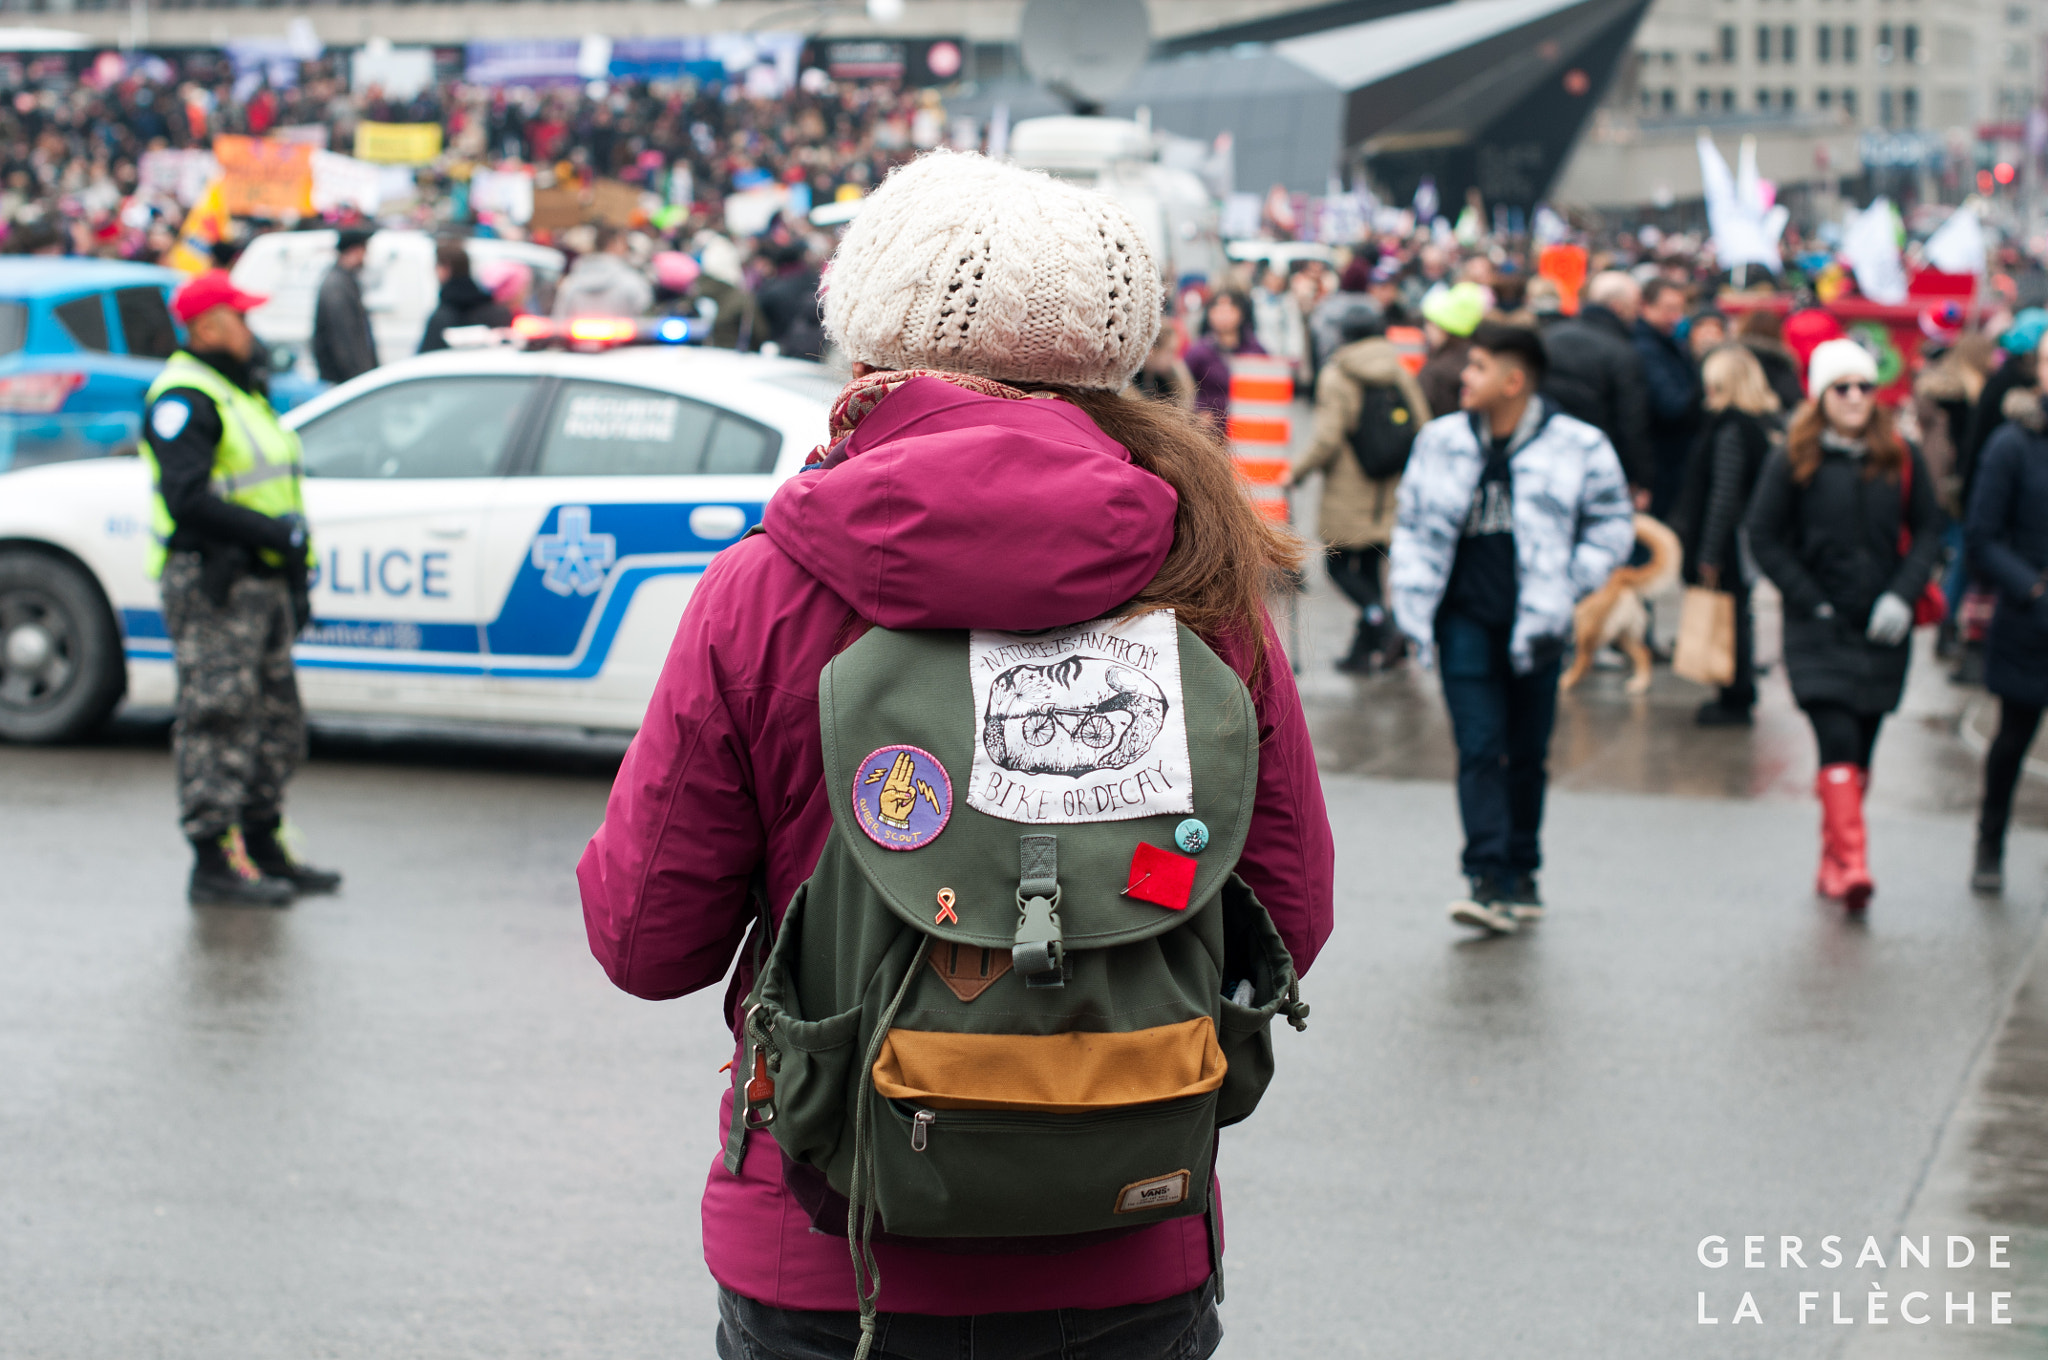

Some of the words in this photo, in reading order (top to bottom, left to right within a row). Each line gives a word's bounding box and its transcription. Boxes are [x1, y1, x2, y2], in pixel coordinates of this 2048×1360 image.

[981, 641, 1050, 671] NATURE
[1053, 636, 1076, 655] IS
[1078, 631, 1159, 671] ANARCHY
[978, 771, 1052, 820] BIKE
[1063, 788, 1092, 817] OR
[1091, 759, 1174, 813] DECAY
[859, 797, 880, 834] QUEER
[884, 829, 923, 843] SCOUT
